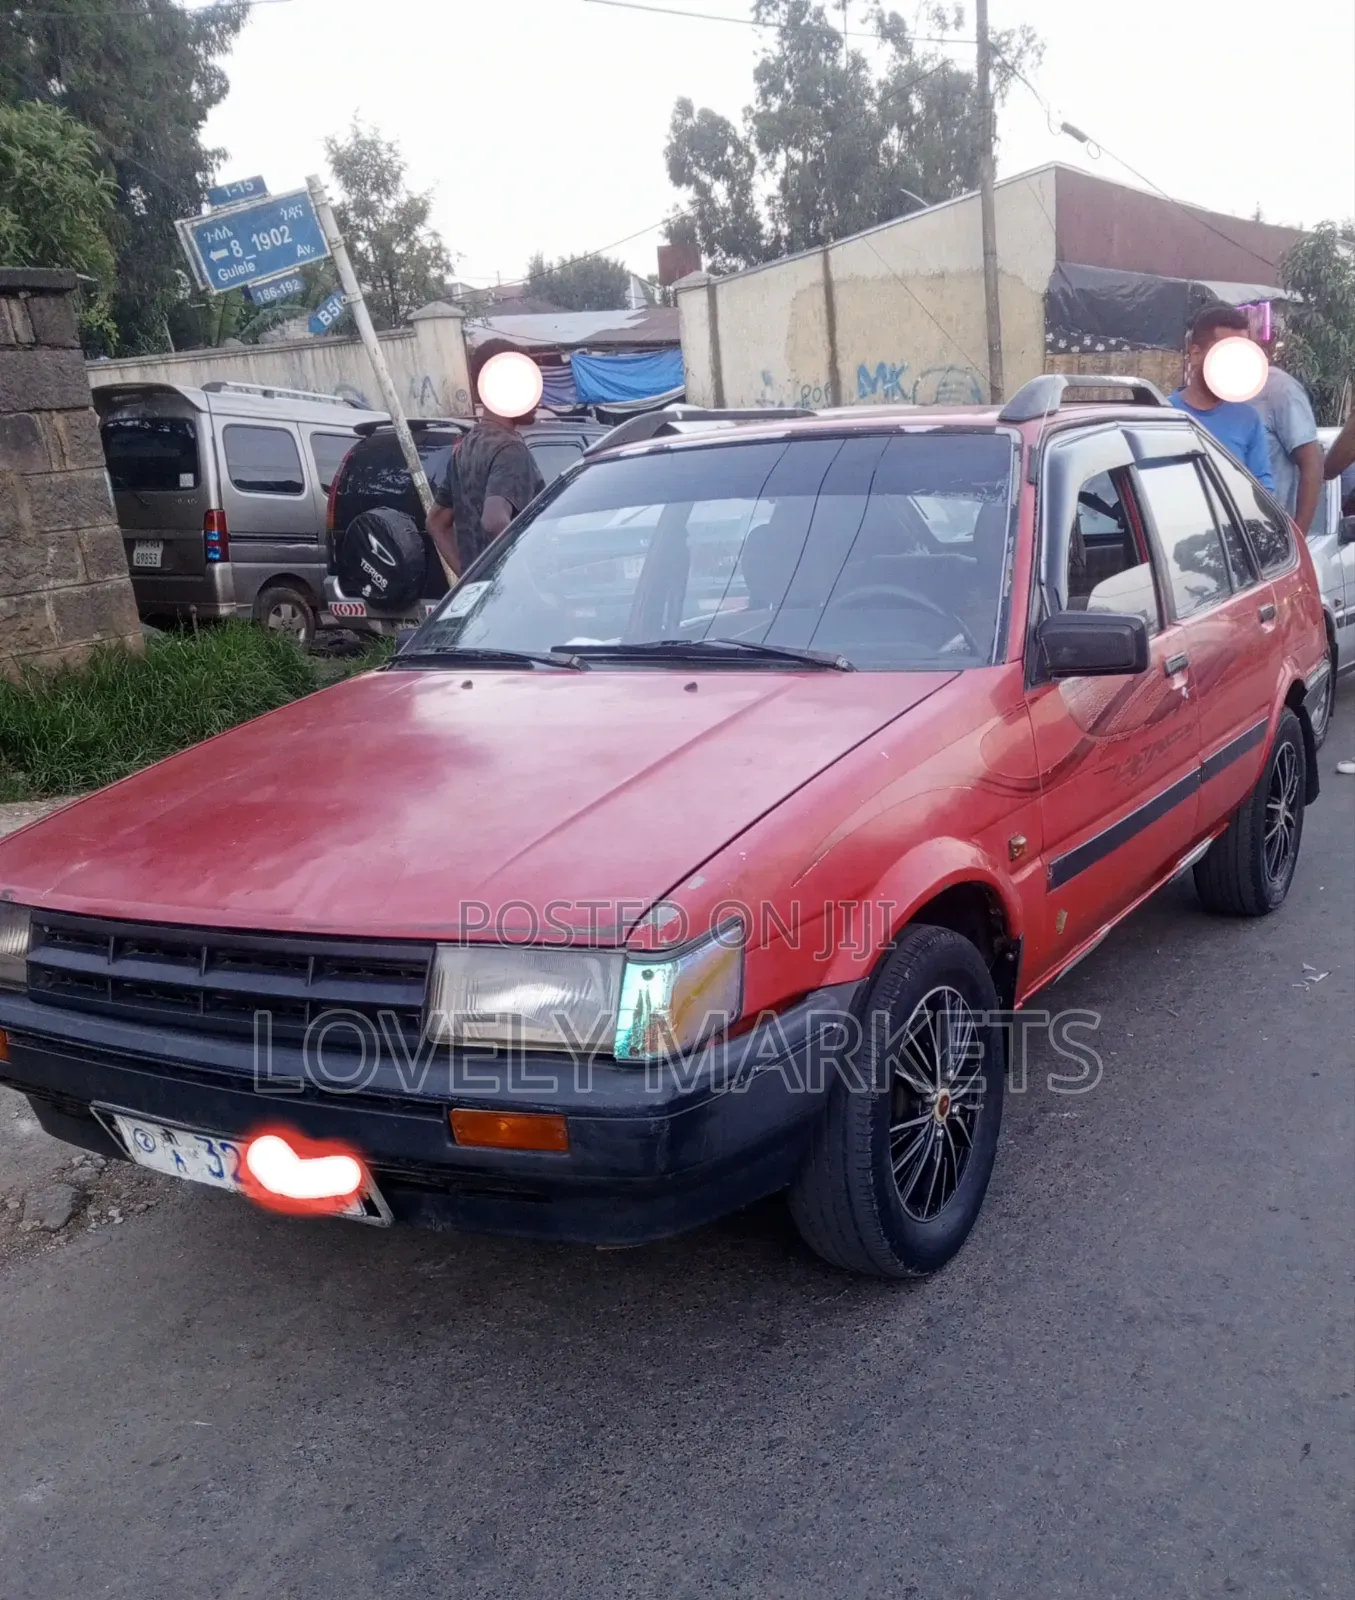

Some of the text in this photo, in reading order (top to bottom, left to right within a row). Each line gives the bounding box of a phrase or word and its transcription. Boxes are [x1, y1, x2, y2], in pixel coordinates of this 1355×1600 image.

[224, 181, 254, 197] 1-15
[217, 260, 256, 281] Gulele
[256, 278, 301, 302] 186-192
[360, 557, 389, 589] TERIOS
